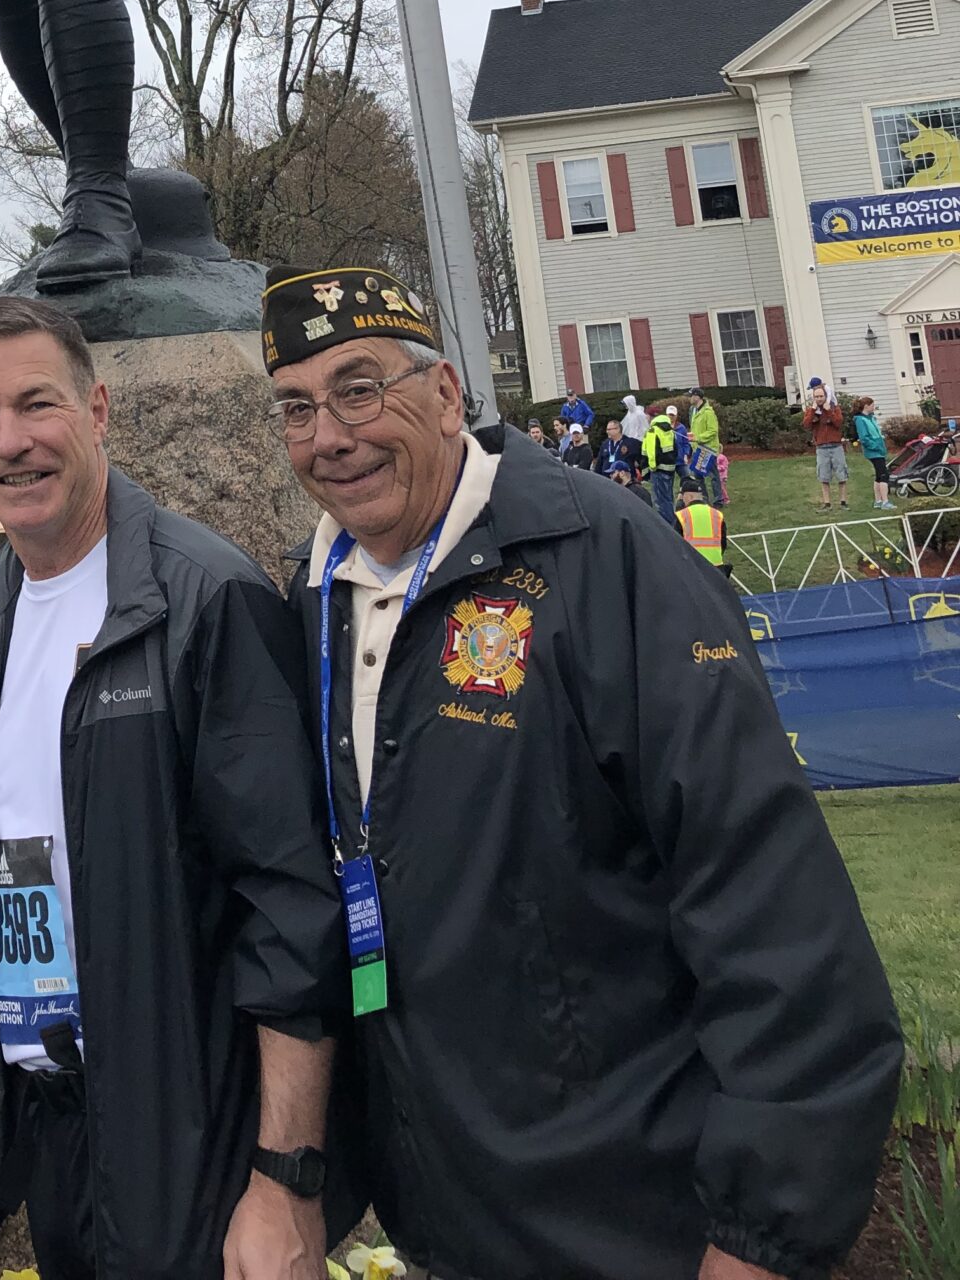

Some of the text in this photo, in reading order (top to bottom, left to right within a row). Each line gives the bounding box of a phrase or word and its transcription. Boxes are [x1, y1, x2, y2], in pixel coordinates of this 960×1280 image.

[859, 204, 892, 218] THE
[856, 240, 932, 255] Welcome
[937, 237, 954, 248] to
[906, 311, 960, 324] ONE AS
[502, 568, 549, 599] 2331
[693, 640, 738, 664] Frank
